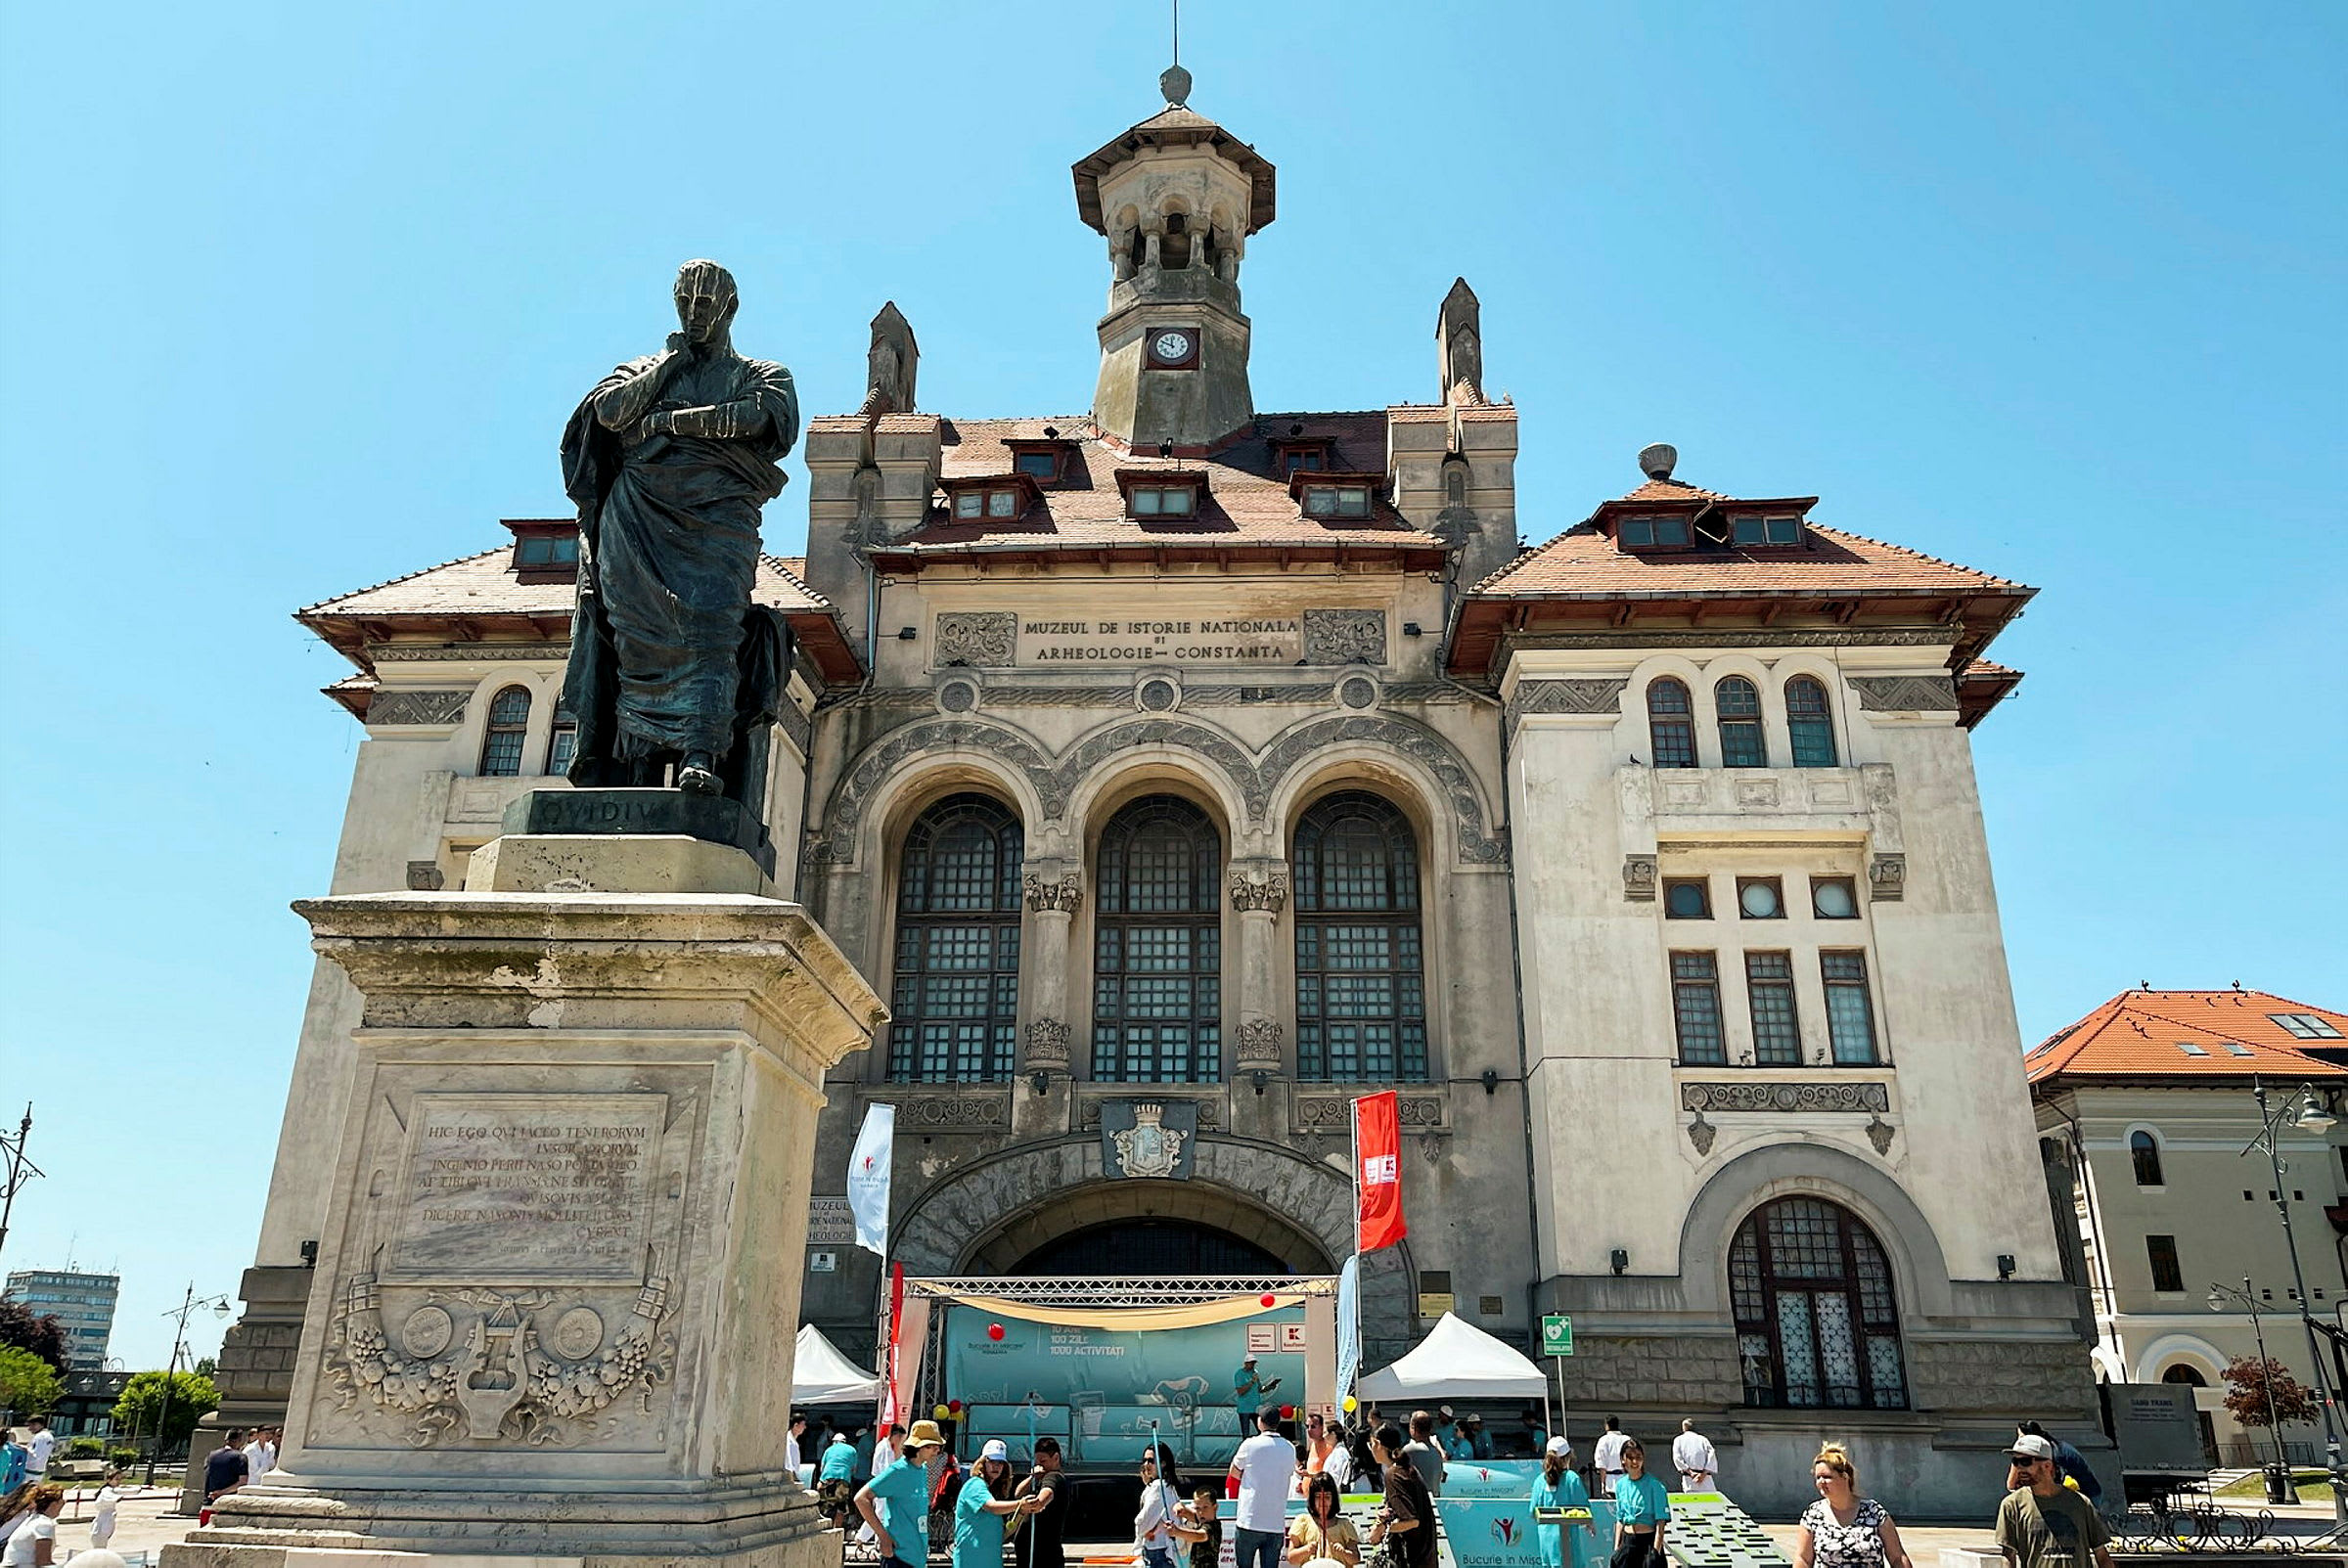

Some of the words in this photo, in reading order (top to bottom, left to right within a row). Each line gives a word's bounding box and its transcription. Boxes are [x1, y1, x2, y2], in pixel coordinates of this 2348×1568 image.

[1025, 622, 1089, 634] MUZEUL
[1099, 622, 1118, 634] DE
[1128, 621, 1192, 634] ISTORIE
[1200, 621, 1298, 633] NATIONALA
[1037, 648, 1153, 660] ARHEOLOGIE
[1175, 647, 1284, 658] CONSTANTA
[1462, 1553, 1503, 1564] Bucurie
